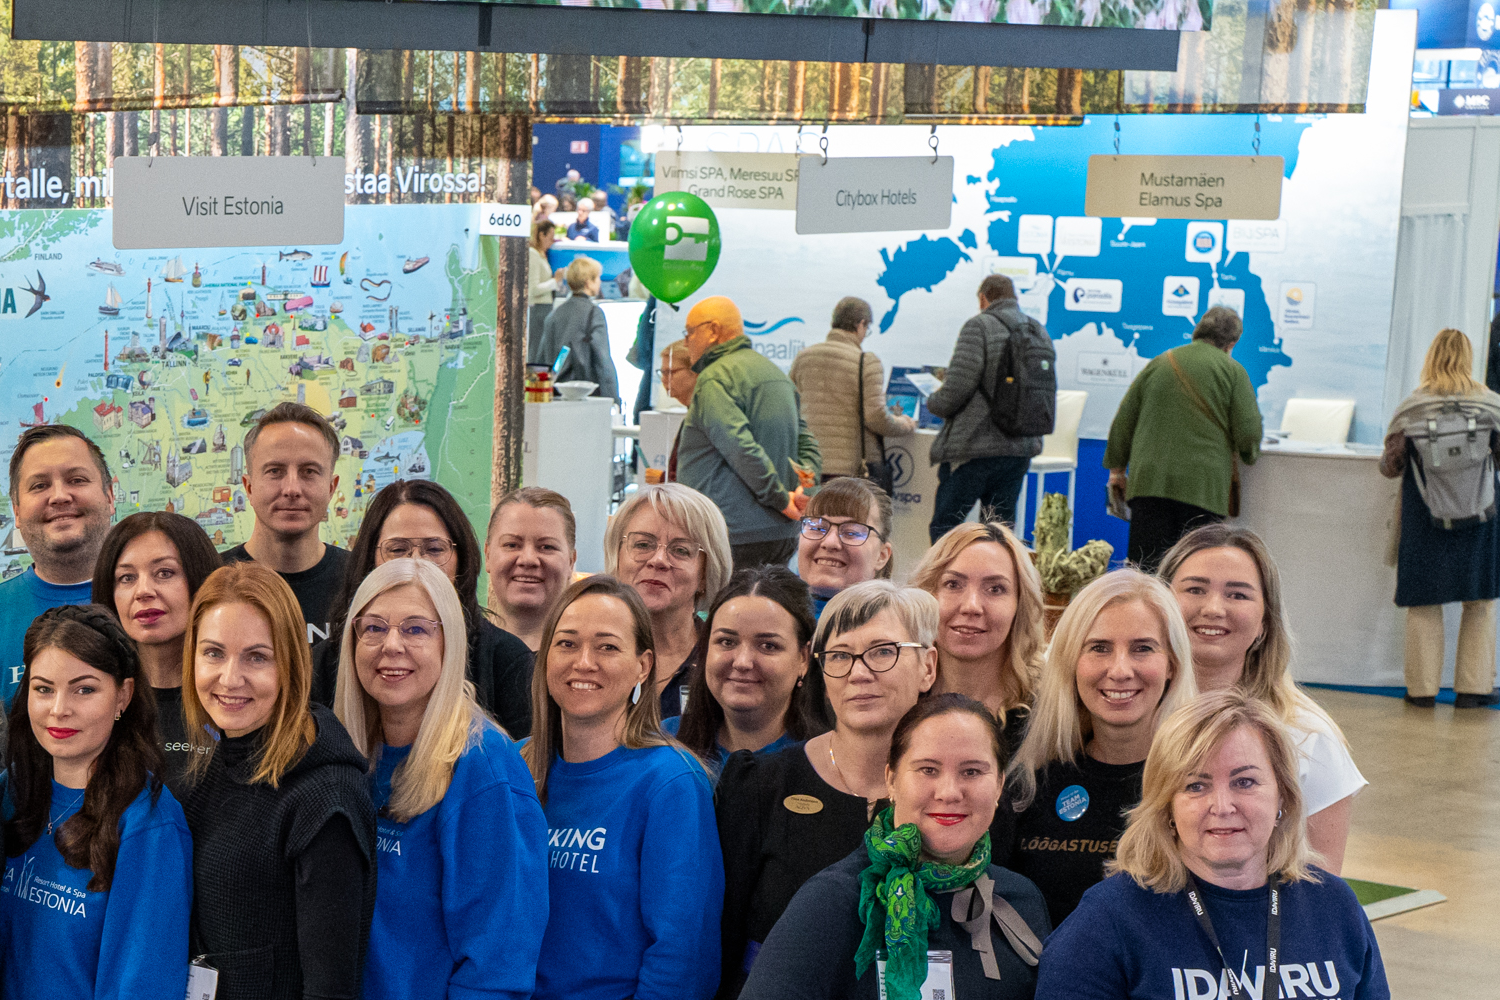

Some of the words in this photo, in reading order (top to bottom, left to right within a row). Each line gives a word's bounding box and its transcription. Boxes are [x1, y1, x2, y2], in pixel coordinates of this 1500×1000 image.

[396, 165, 486, 194] Virossa!
[662, 165, 698, 181] Viimsi
[700, 166, 728, 183] SPA,
[730, 168, 782, 182] Meresuu
[784, 169, 800, 183] SP
[1140, 172, 1225, 188] Mustamäen
[688, 184, 724, 199] Grand
[726, 185, 757, 200] Rose
[759, 186, 784, 200] SPA
[836, 190, 878, 210] Citybox
[881, 188, 917, 206] Hotels
[1139, 192, 1190, 208] Elamus
[1195, 192, 1223, 211] Spa
[182, 196, 218, 216] Visit
[223, 195, 283, 216] Estonia
[489, 212, 522, 228] 6d60
[34, 253, 62, 261] FINLAND
[162, 360, 186, 368] TALLINN
[1059, 797, 1087, 815] ESTONIA
[1062, 794, 1080, 807] TEAM
[548, 827, 607, 851] KING
[1021, 836, 1118, 854] LÕÕGASTUSE
[550, 850, 600, 873] HOTEL
[34, 875, 50, 887] Resort
[50, 880, 66, 892] Hotel
[72, 886, 87, 899] Spa
[28, 887, 87, 918] ESTONIA
[1188, 890, 1204, 916] IDAVIRU
[1269, 947, 1277, 973] IDAVIRU
